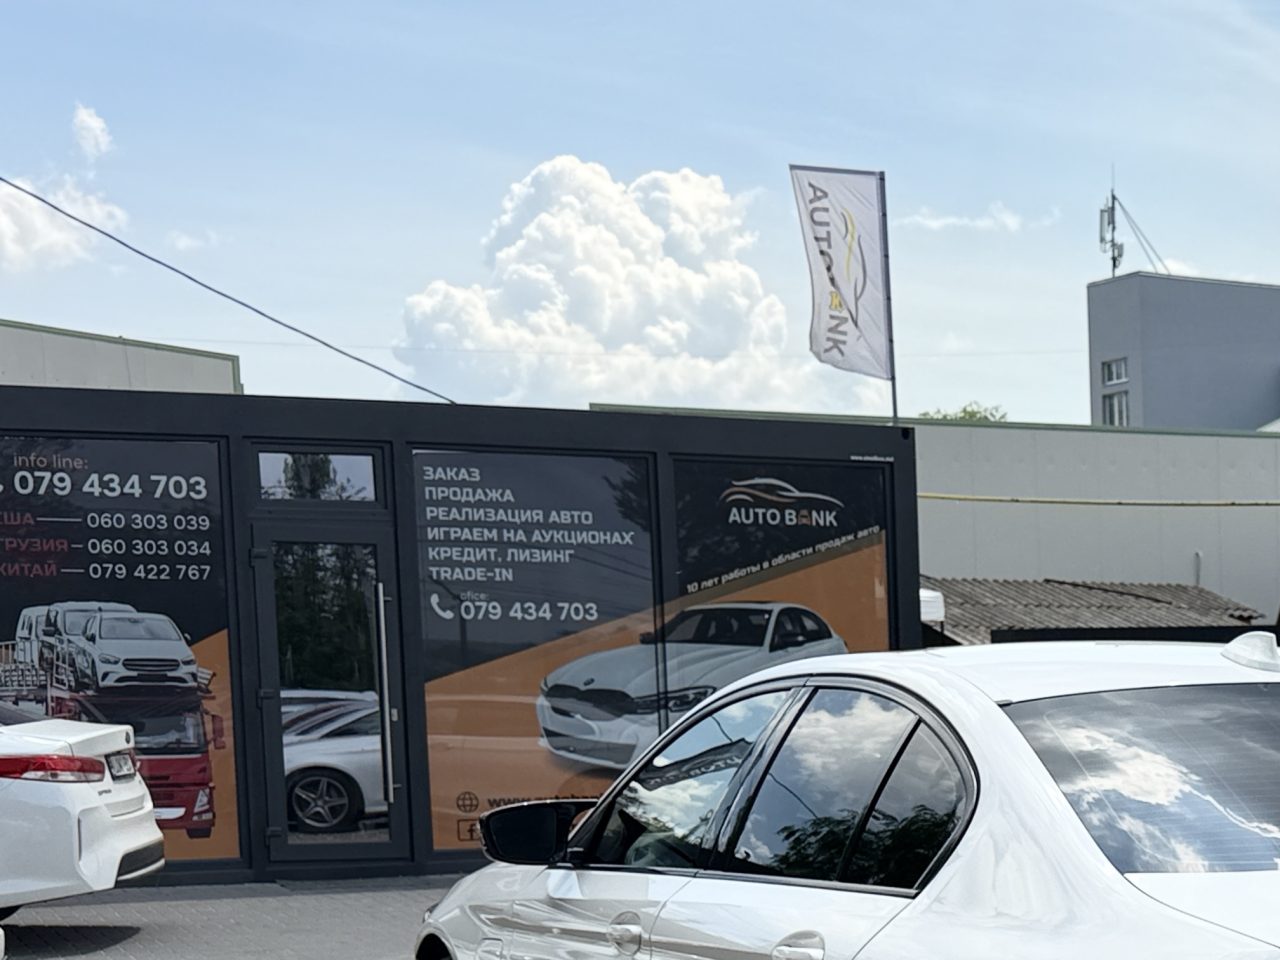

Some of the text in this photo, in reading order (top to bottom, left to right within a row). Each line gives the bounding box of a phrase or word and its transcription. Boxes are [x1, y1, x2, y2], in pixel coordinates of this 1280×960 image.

[13, 453, 89, 469] info line:
[423, 466, 481, 481] ЗАКАЗ
[14, 470, 208, 500] 079 434 703
[424, 487, 515, 503] ПРОДАЖА
[87, 512, 126, 529] 060
[131, 513, 168, 529] 303
[173, 515, 210, 530] 039
[426, 507, 593, 524] РЕАЛИЗАЦИЯ АВТО
[728, 507, 781, 526] AUTO
[427, 527, 635, 545] ИГРАЕМ НА АУКЦИОНАХ
[87, 538, 126, 555] 060
[132, 540, 169, 556] 303
[174, 541, 212, 556] 034
[506, 549, 575, 563] ЛИЗИНГ
[686, 581, 699, 594] 10
[700, 576, 720, 589] лет
[721, 564, 761, 584] работы
[771, 546, 814, 566] области
[815, 533, 855, 552] продаж
[857, 525, 880, 538] авто
[89, 563, 127, 579] 079
[133, 565, 171, 580] 422
[176, 565, 212, 580] 767
[429, 567, 514, 581] TRADE-IN
[460, 601, 599, 621] 079 434 703
